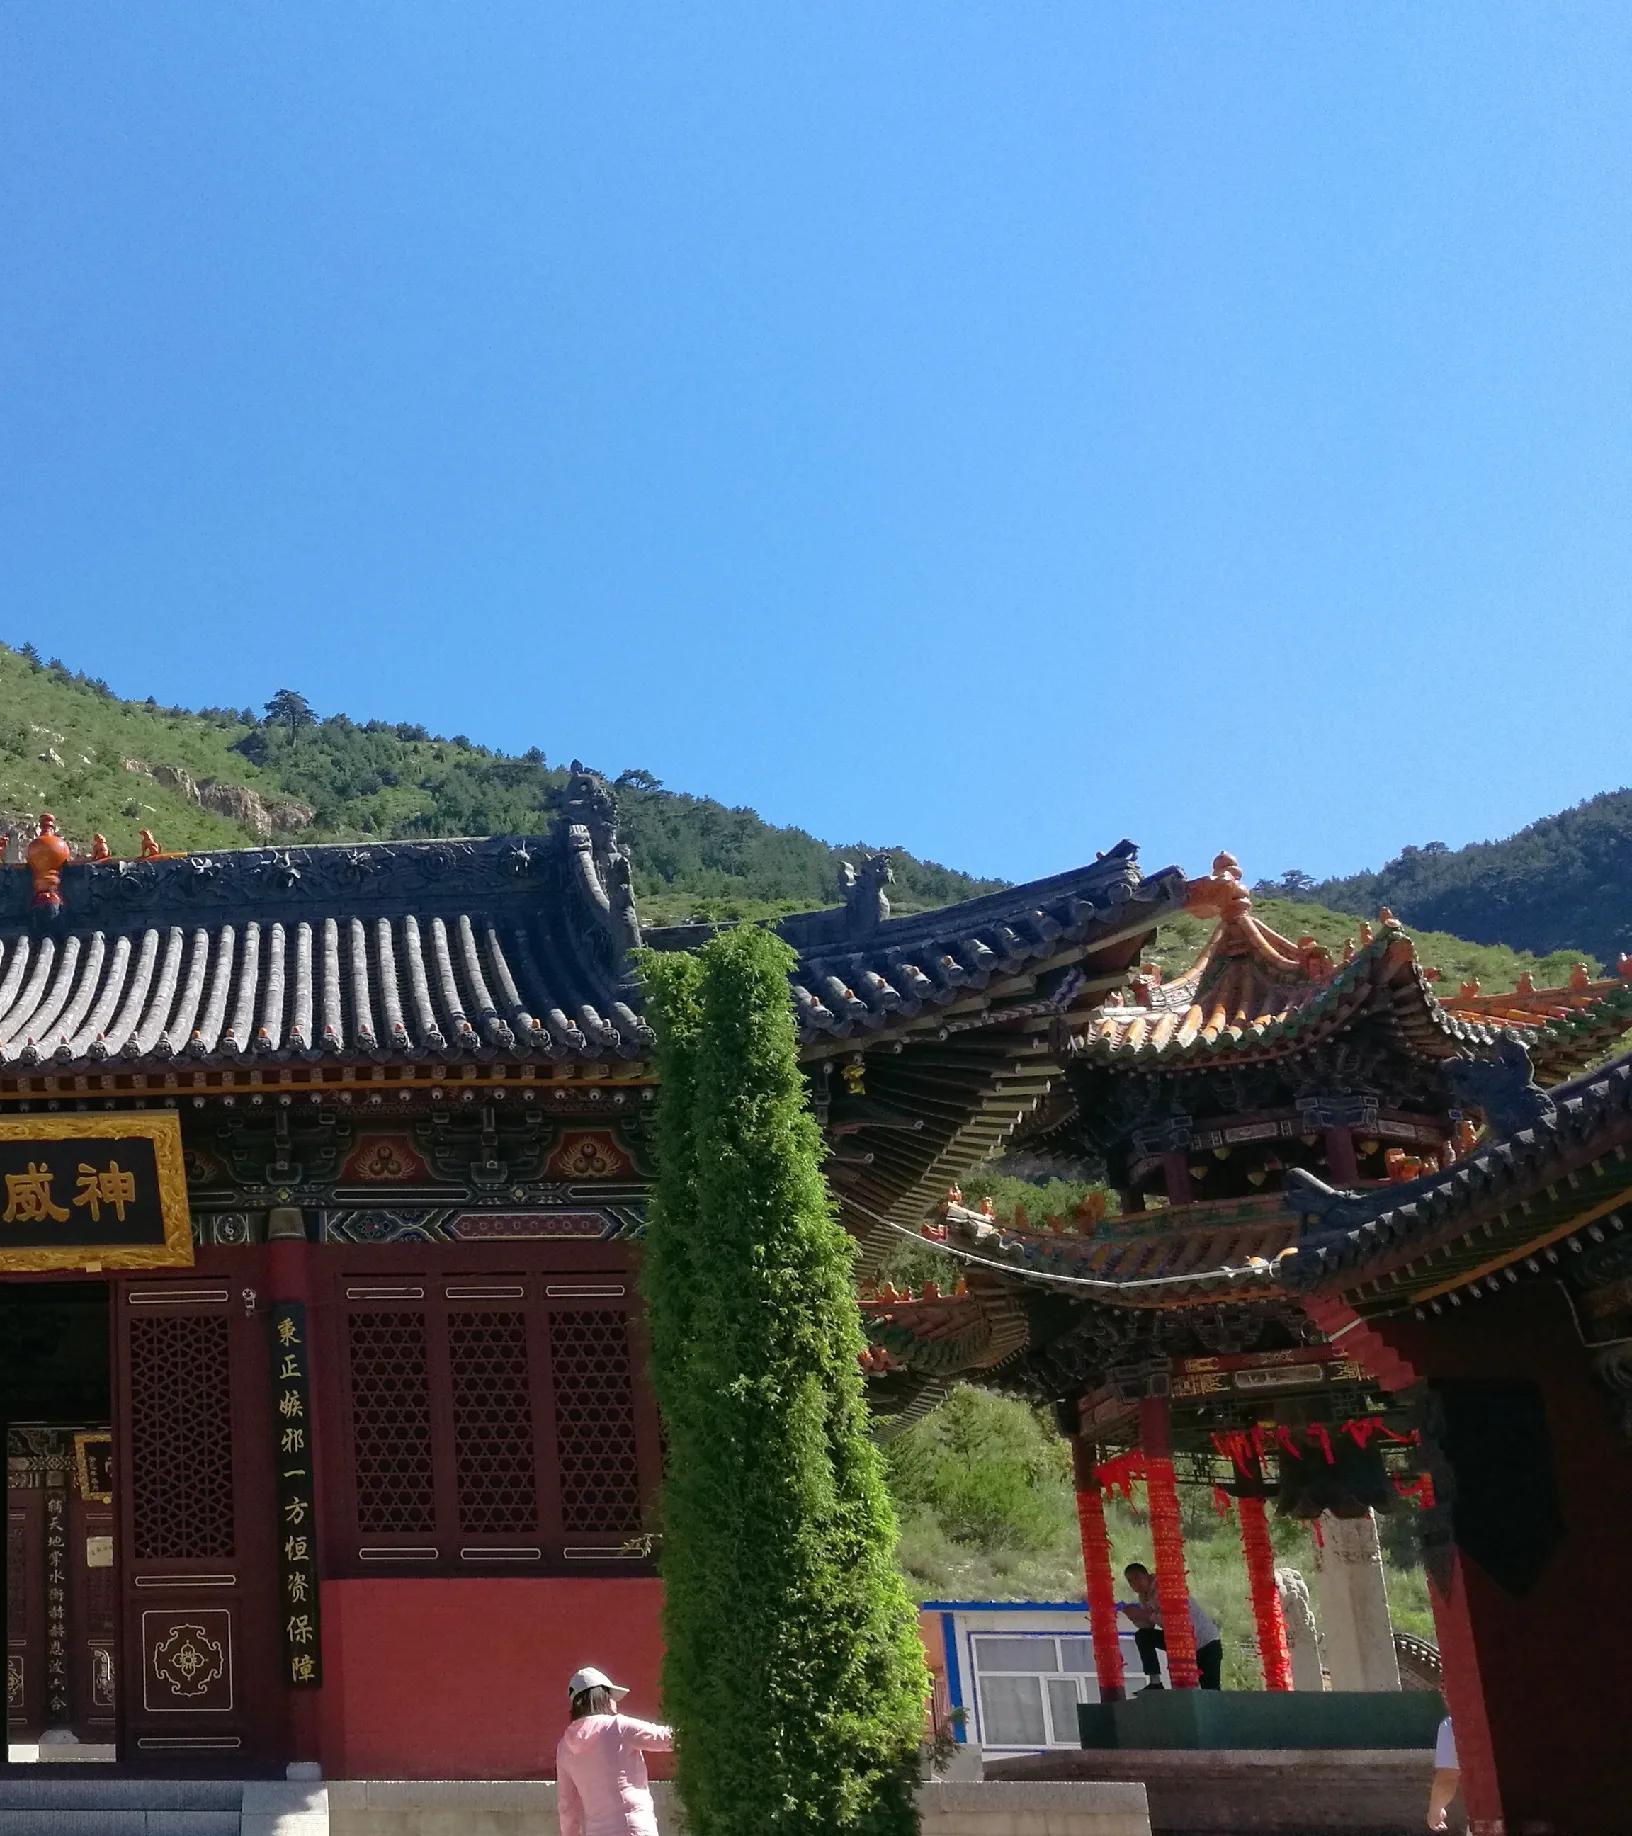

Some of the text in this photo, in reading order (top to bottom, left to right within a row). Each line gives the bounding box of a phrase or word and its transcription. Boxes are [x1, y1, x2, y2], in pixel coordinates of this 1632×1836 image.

[276, 1317, 317, 1684] 秉正嫉邪一方恒资保障
